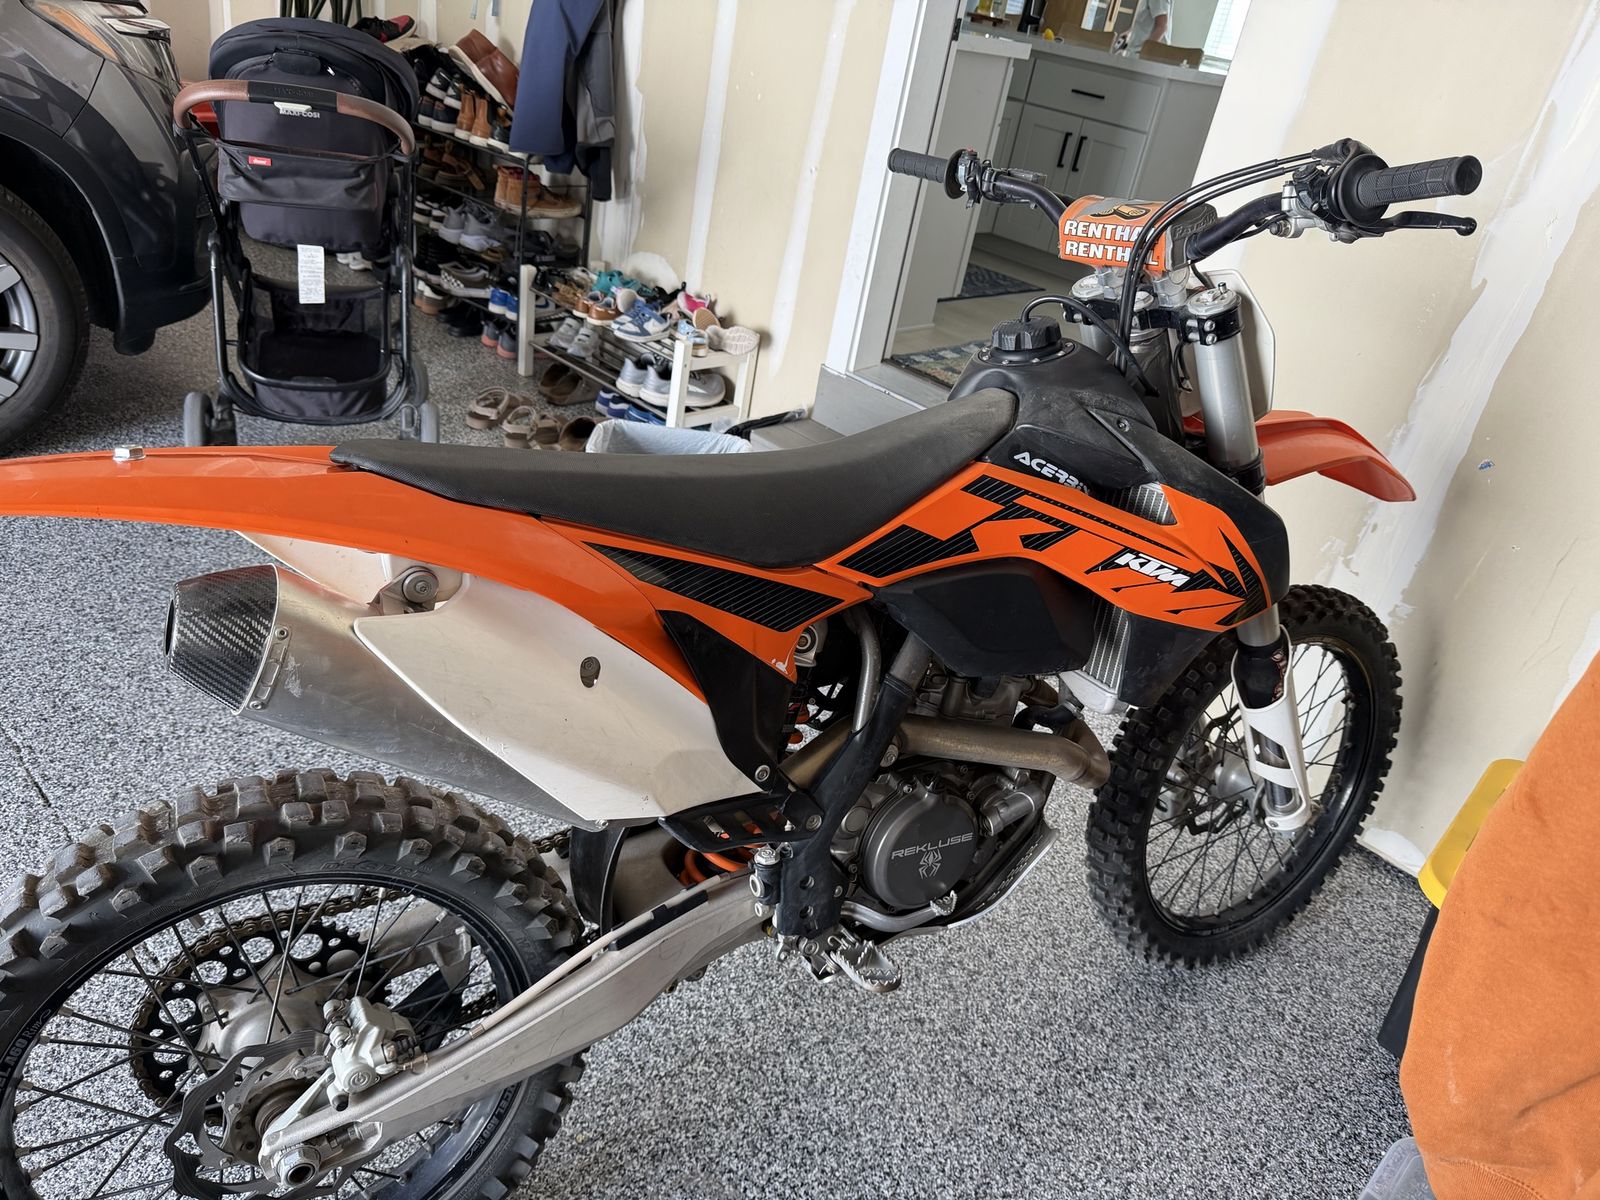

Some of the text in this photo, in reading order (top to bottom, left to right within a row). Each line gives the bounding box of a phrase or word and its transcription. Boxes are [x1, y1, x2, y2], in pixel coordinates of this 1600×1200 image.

[1064, 240, 1159, 266] RENTHL
[1013, 451, 1090, 494] ACERB
[1114, 553, 1190, 587] KTM
[891, 832, 973, 860] REKLUSE
